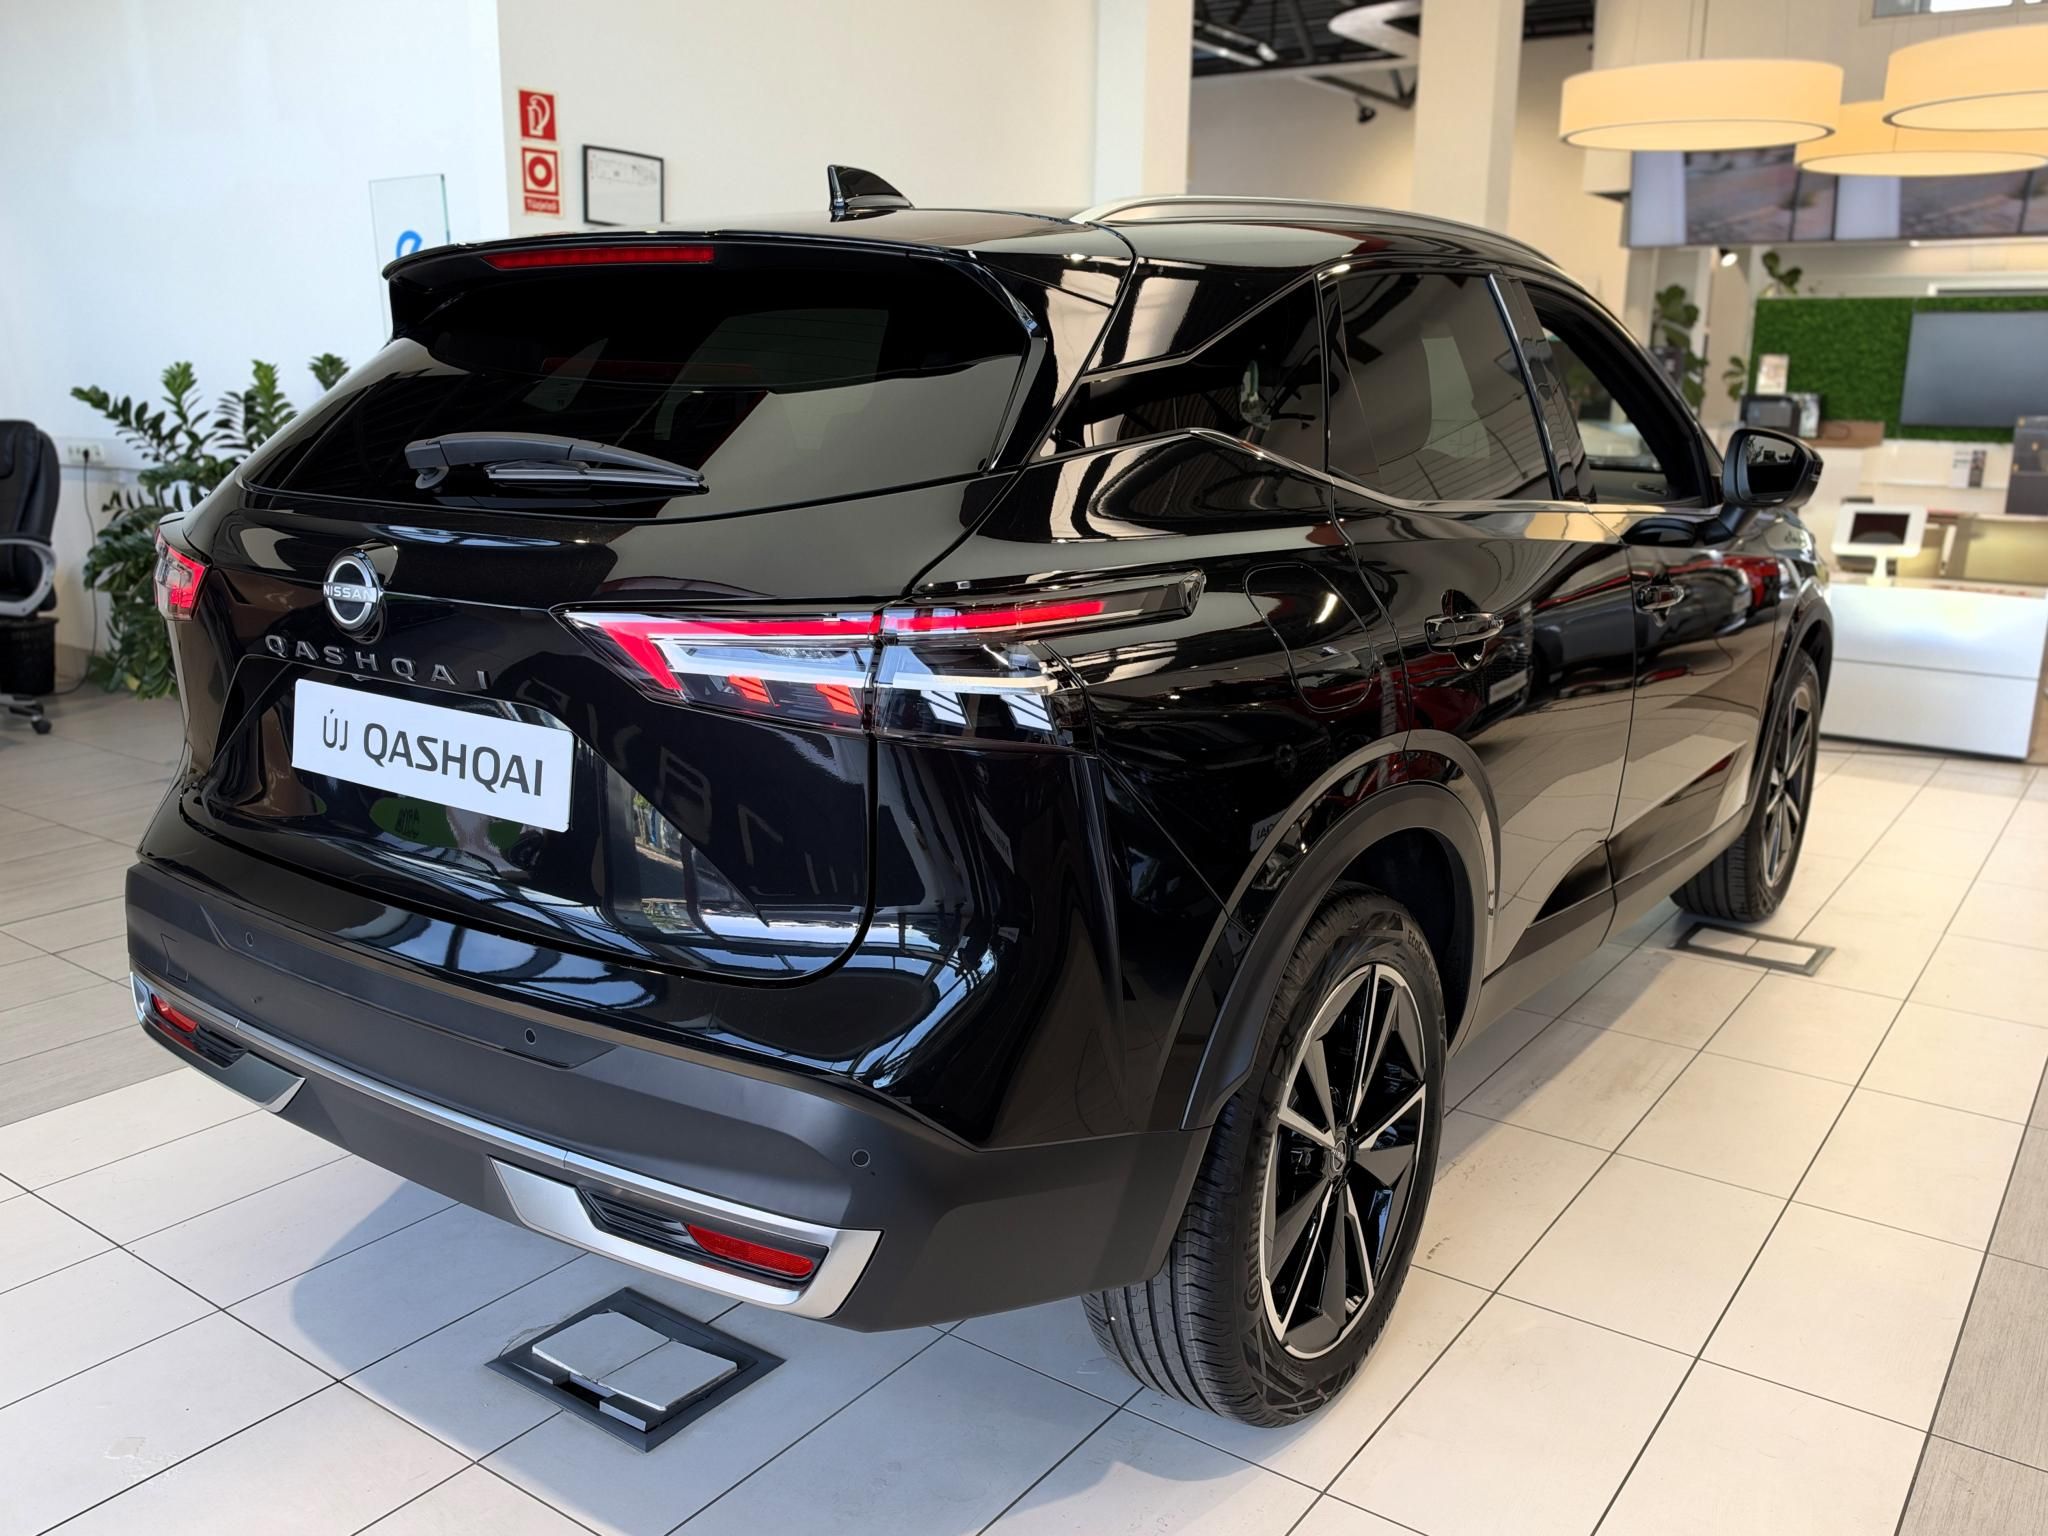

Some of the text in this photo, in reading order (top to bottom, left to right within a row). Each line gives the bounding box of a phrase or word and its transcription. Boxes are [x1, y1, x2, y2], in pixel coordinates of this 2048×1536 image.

[323, 584, 372, 601] NISSAN
[264, 634, 491, 689] QASHQAI
[322, 708, 543, 797] ÚJ QASHQAI
